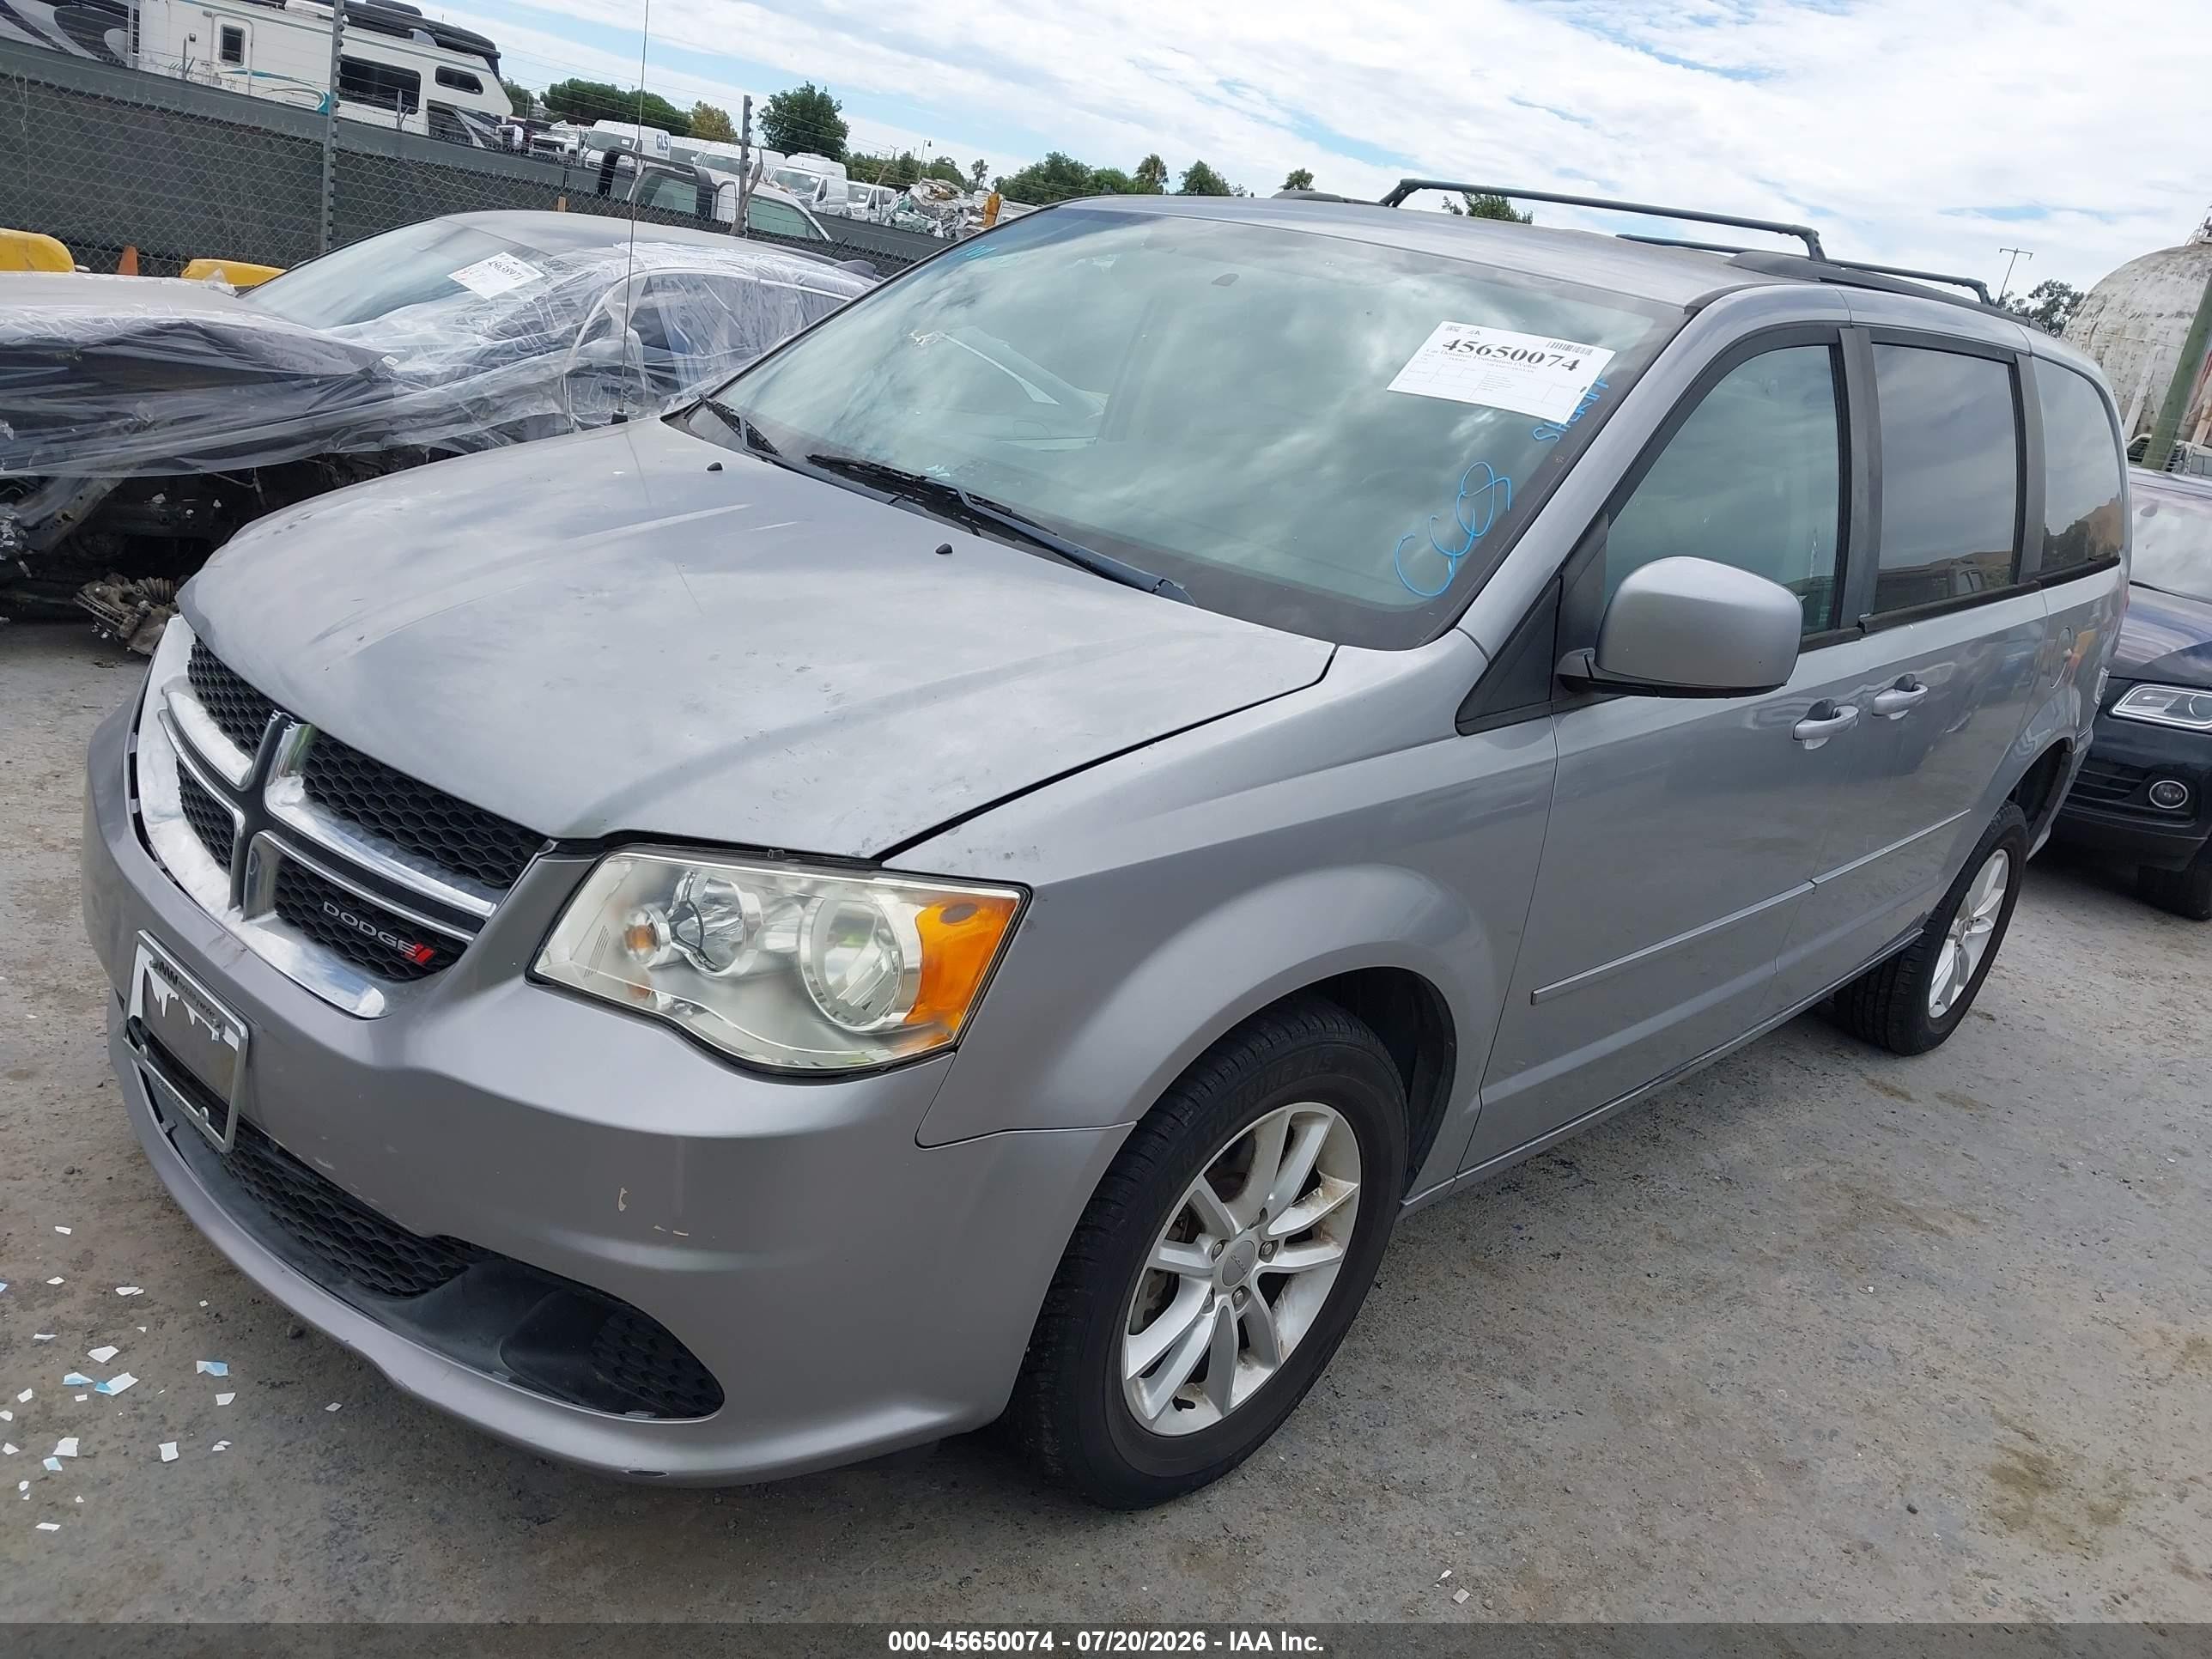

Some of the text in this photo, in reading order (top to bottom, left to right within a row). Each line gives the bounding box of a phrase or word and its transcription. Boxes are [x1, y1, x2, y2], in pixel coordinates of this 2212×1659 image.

[656, 134, 669, 151] GLS
[1442, 338, 1581, 371] 45650074
[323, 901, 417, 957] DODGE
